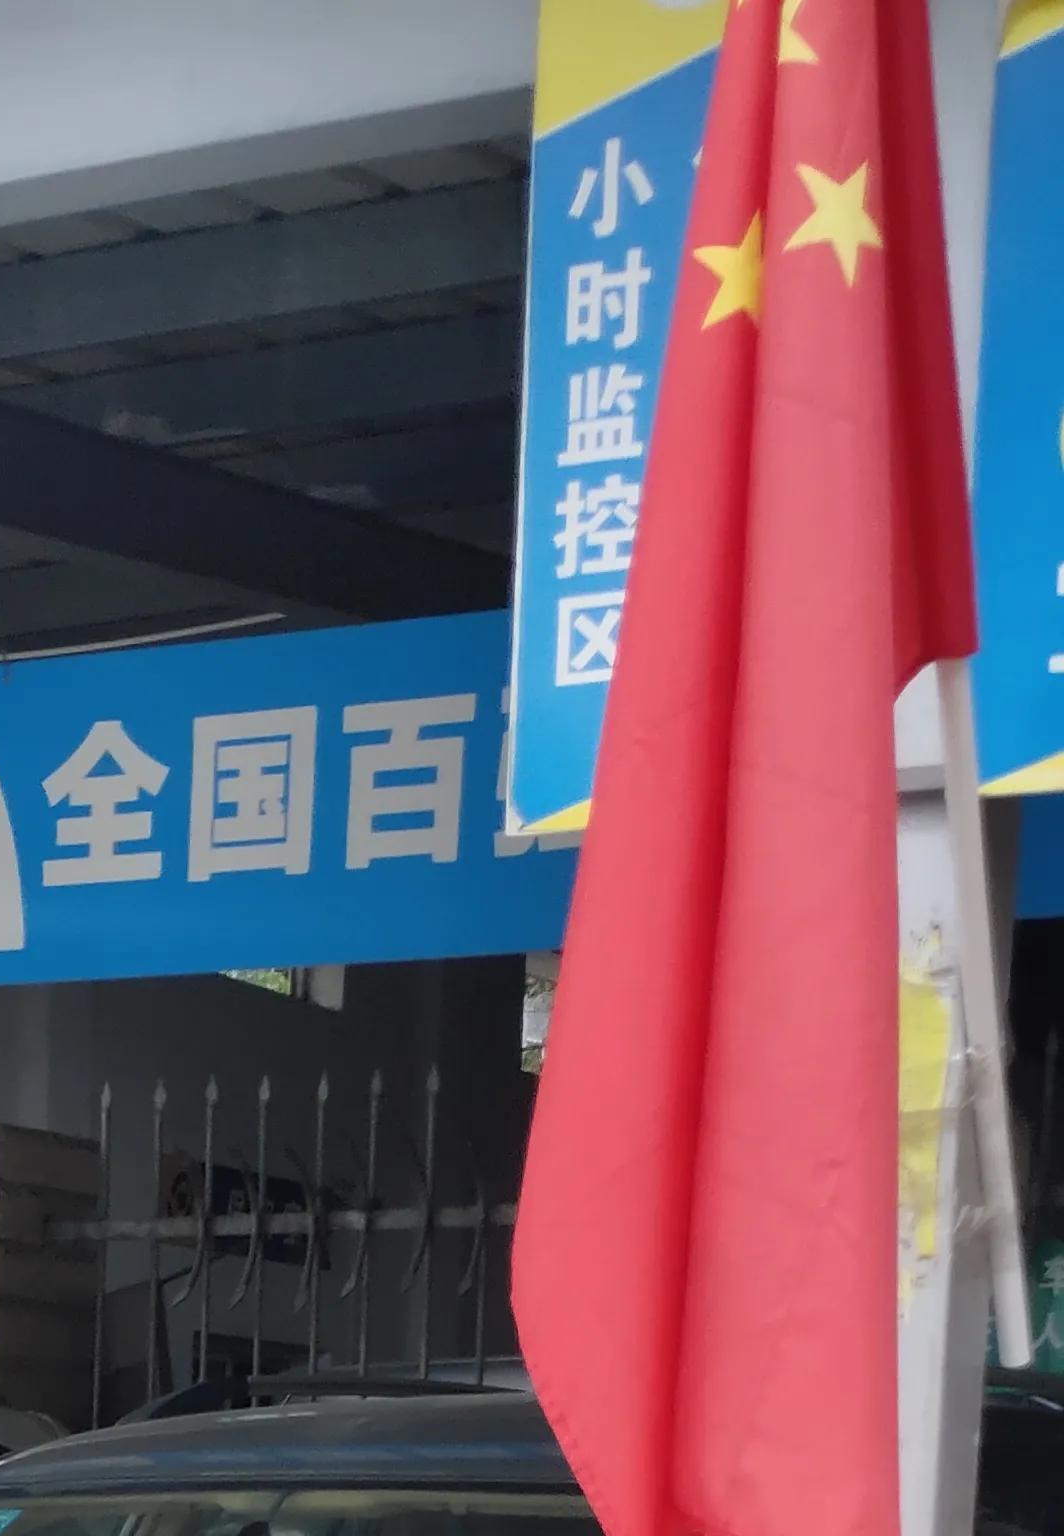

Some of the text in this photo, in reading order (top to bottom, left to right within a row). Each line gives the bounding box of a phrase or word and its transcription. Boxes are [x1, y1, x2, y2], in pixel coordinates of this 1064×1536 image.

[553, 136, 655, 688] 小时监控区
[40, 692, 586, 887] 全国百
